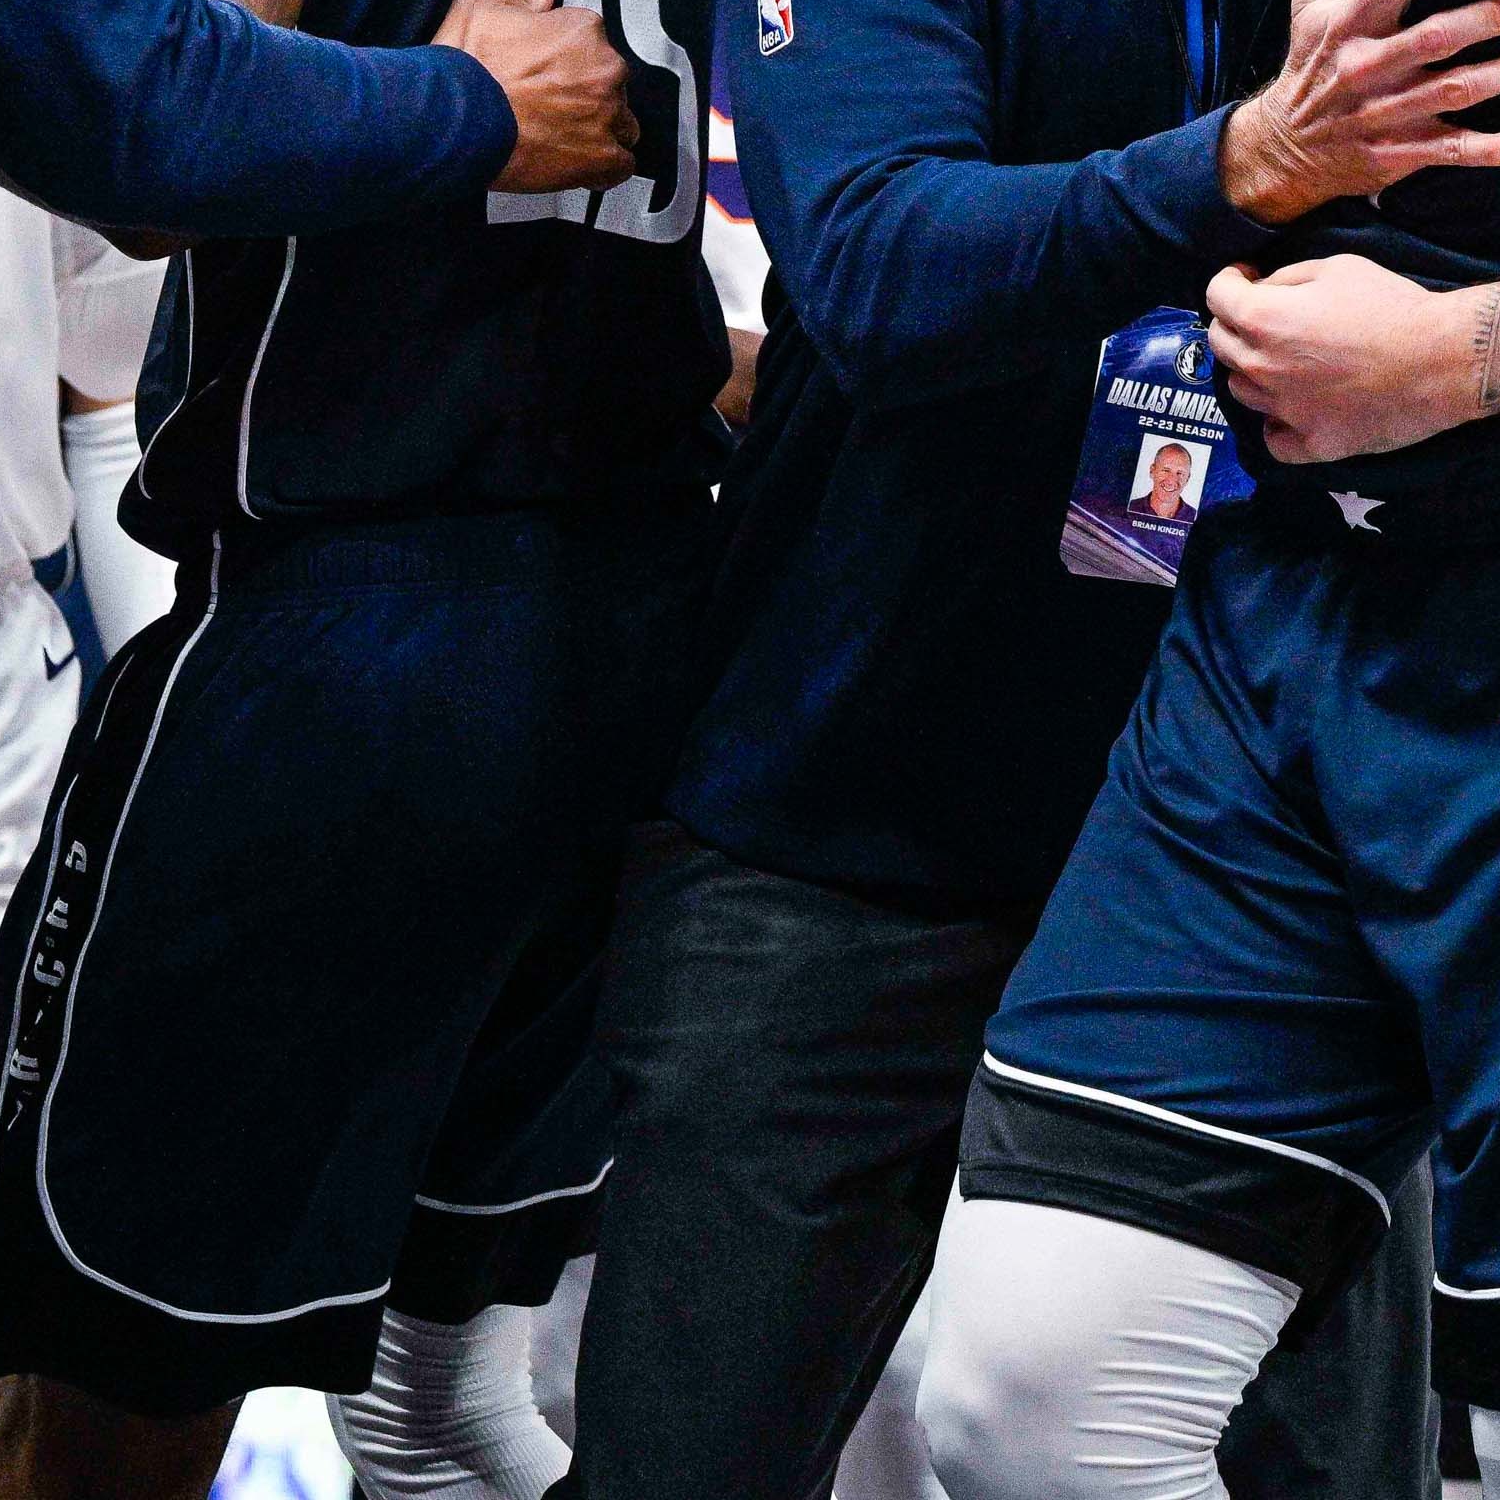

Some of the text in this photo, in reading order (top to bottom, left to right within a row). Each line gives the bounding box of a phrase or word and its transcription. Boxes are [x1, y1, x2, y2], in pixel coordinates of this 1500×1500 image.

[762, 29, 782, 51] NBA
[1106, 377, 1172, 414] DALLAS
[1138, 415, 1225, 441] 22-23 SEASON
[1132, 520, 1185, 537] BRIAN KINZIG
